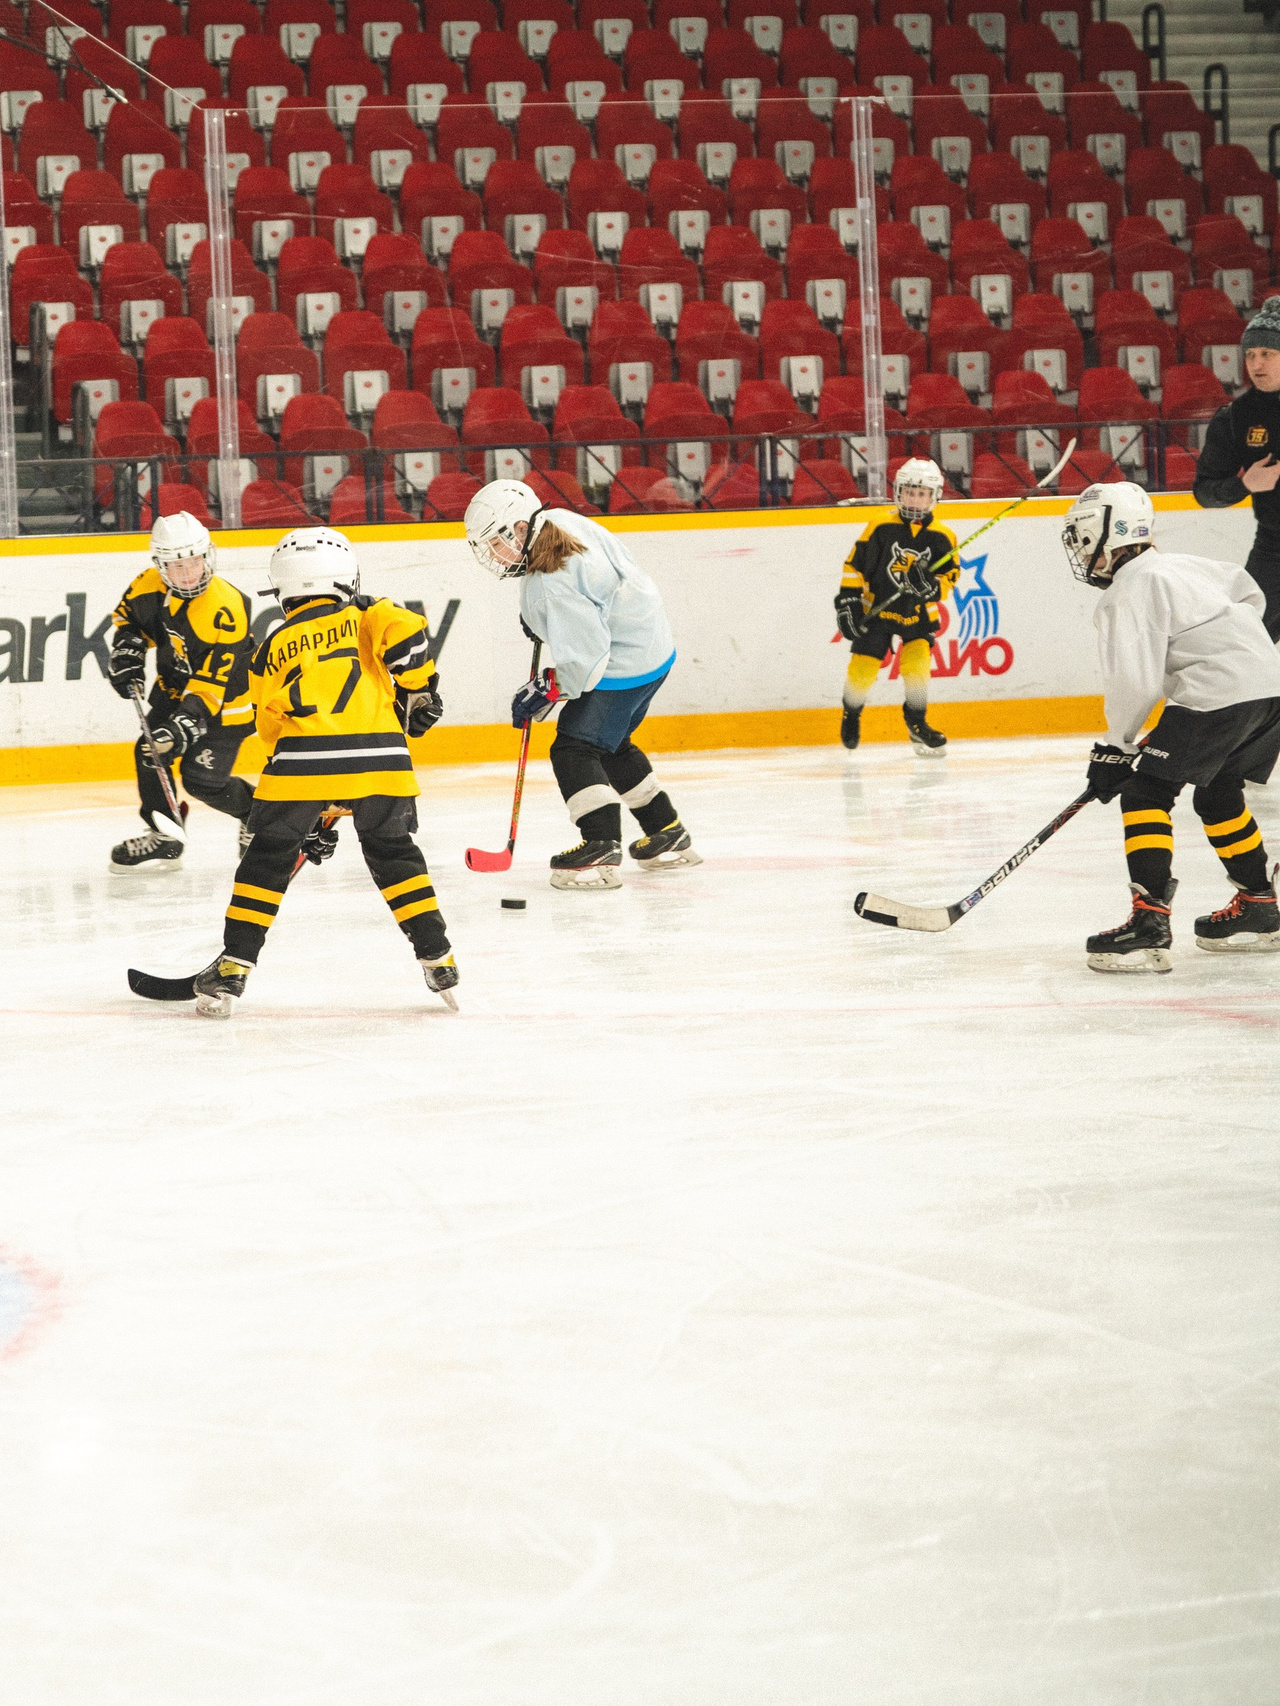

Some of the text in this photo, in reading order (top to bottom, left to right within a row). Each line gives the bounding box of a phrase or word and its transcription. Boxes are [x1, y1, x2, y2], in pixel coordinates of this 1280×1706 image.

[196, 651, 235, 683] 12
[282, 647, 362, 718] 17
[981, 837, 1040, 898] BAUER
